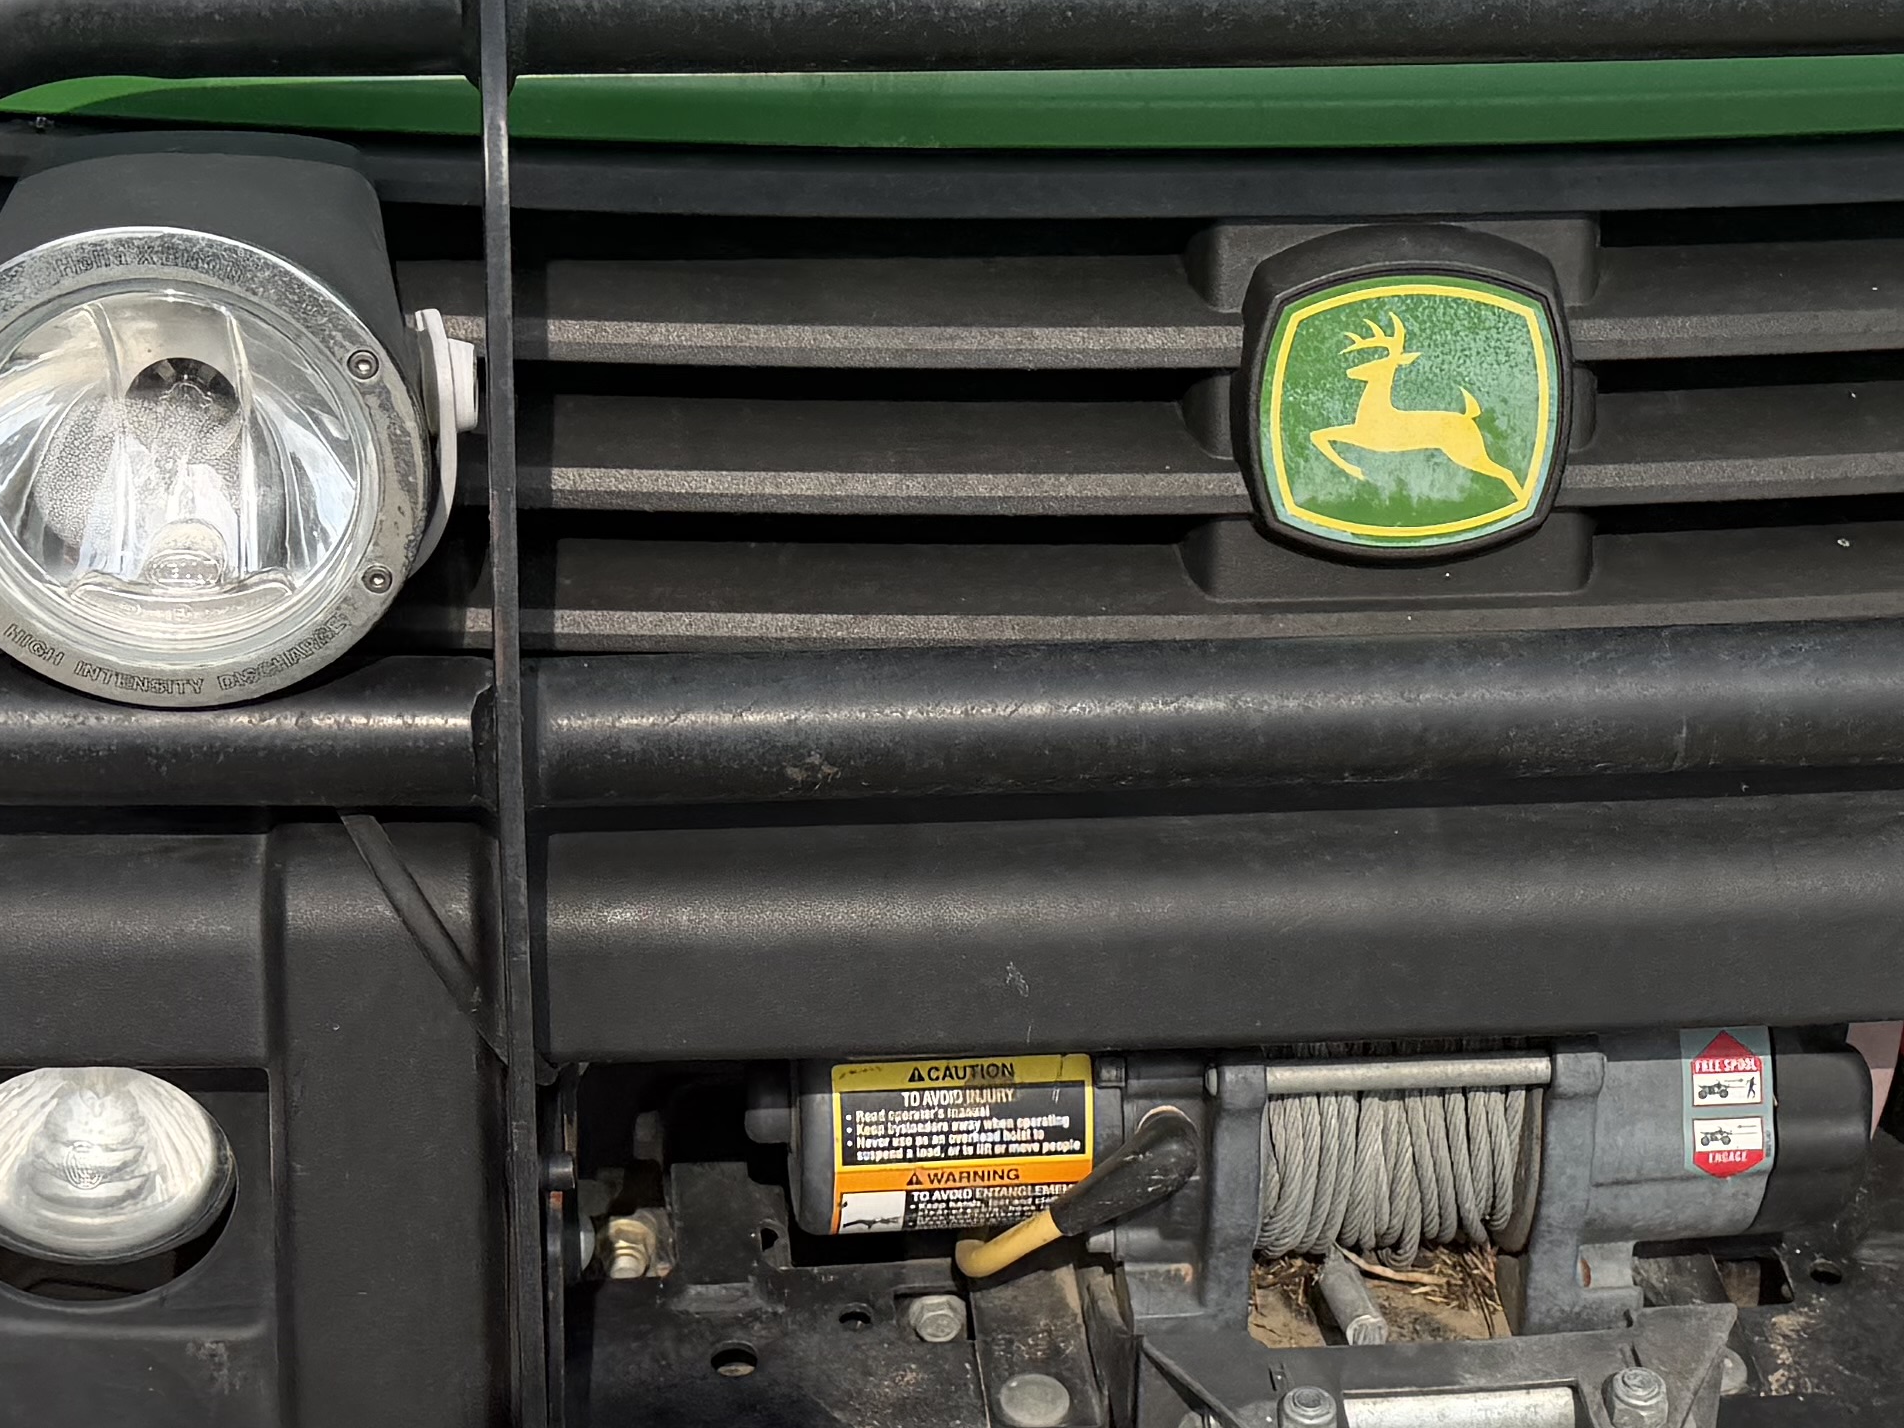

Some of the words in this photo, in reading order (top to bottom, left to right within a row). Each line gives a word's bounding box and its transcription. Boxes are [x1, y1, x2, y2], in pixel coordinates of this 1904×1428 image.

[3, 624, 65, 666] HIGH
[74, 660, 204, 695] INTENSITY
[927, 1062, 1015, 1081] CAUTION
[1695, 1059, 1721, 1072] FREE
[1723, 1058, 1759, 1071] SPOOL
[901, 1091, 920, 1107] TO
[922, 1090, 963, 1107] AVOID
[966, 1088, 1014, 1104] INJURY
[856, 1109, 885, 1122] Read
[948, 1105, 990, 1118] manual
[857, 1122, 884, 1136] Keep
[983, 1117, 1014, 1129] when
[1016, 1114, 1070, 1129] operating
[857, 1136, 890, 1149] Never
[948, 1130, 1001, 1144] overhead
[856, 1148, 903, 1162] suspend
[1009, 1142, 1040, 1153] move
[1042, 1139, 1081, 1154] people
[1708, 1150, 1748, 1164] ENGAGE
[928, 1169, 1020, 1185] WARNING
[911, 1187, 930, 1202] TO
[932, 1185, 972, 1201] AVOID
